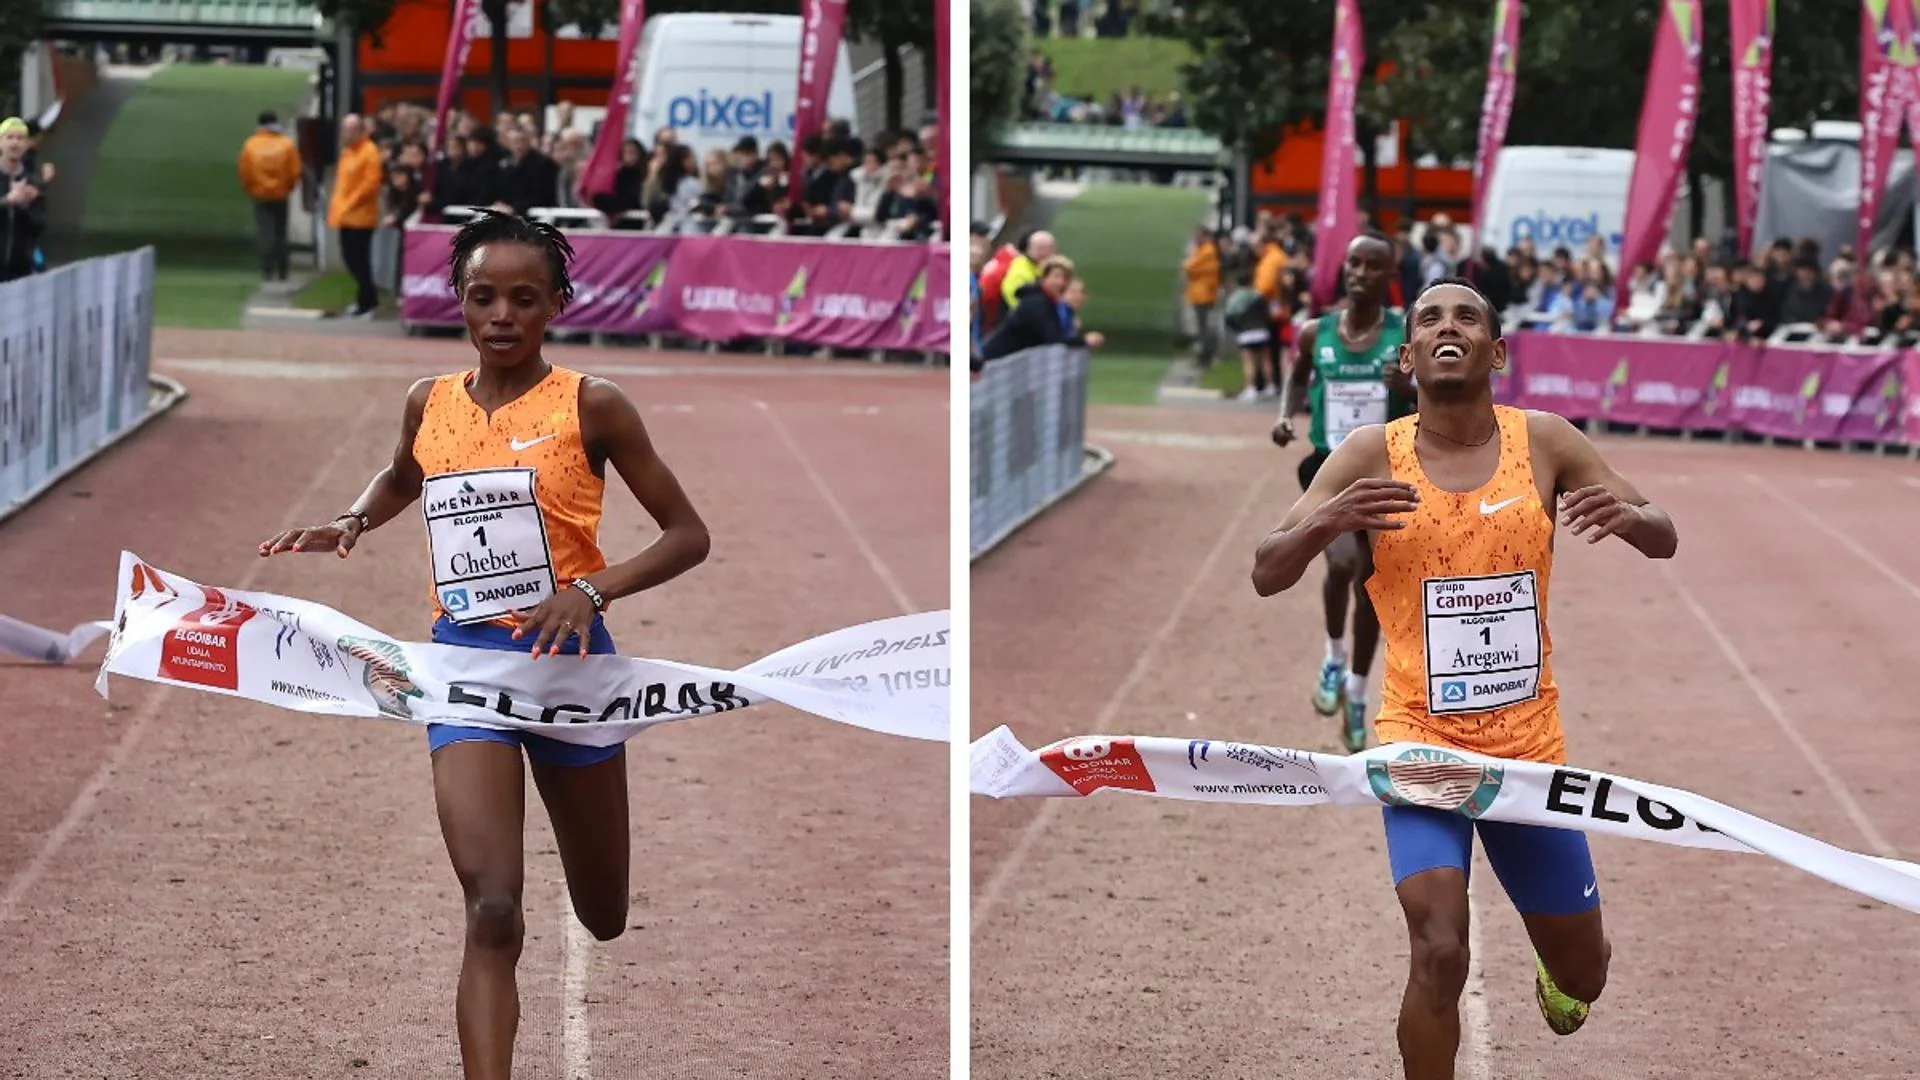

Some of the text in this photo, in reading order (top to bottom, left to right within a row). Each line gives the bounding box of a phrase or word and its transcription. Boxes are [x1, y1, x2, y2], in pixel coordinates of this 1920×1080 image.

[669, 89, 773, 129] pixel
[1511, 208, 1598, 248] pixel
[430, 491, 520, 513] AMENABAR
[453, 511, 503, 526] ELGOIBAR
[473, 526, 488, 547] 1
[450, 548, 520, 577] Chebet
[475, 580, 542, 603] DANOBAT
[1435, 582, 1465, 594] grupo
[1436, 590, 1513, 611] campezo
[1460, 615, 1505, 625] ELGOIBAR
[175, 628, 227, 649] ELGOIBAR
[1479, 626, 1491, 645] 1
[1452, 643, 1520, 671] Aregawi
[1473, 678, 1529, 696] DANOBAT
[1546, 768, 1722, 833] ELG
